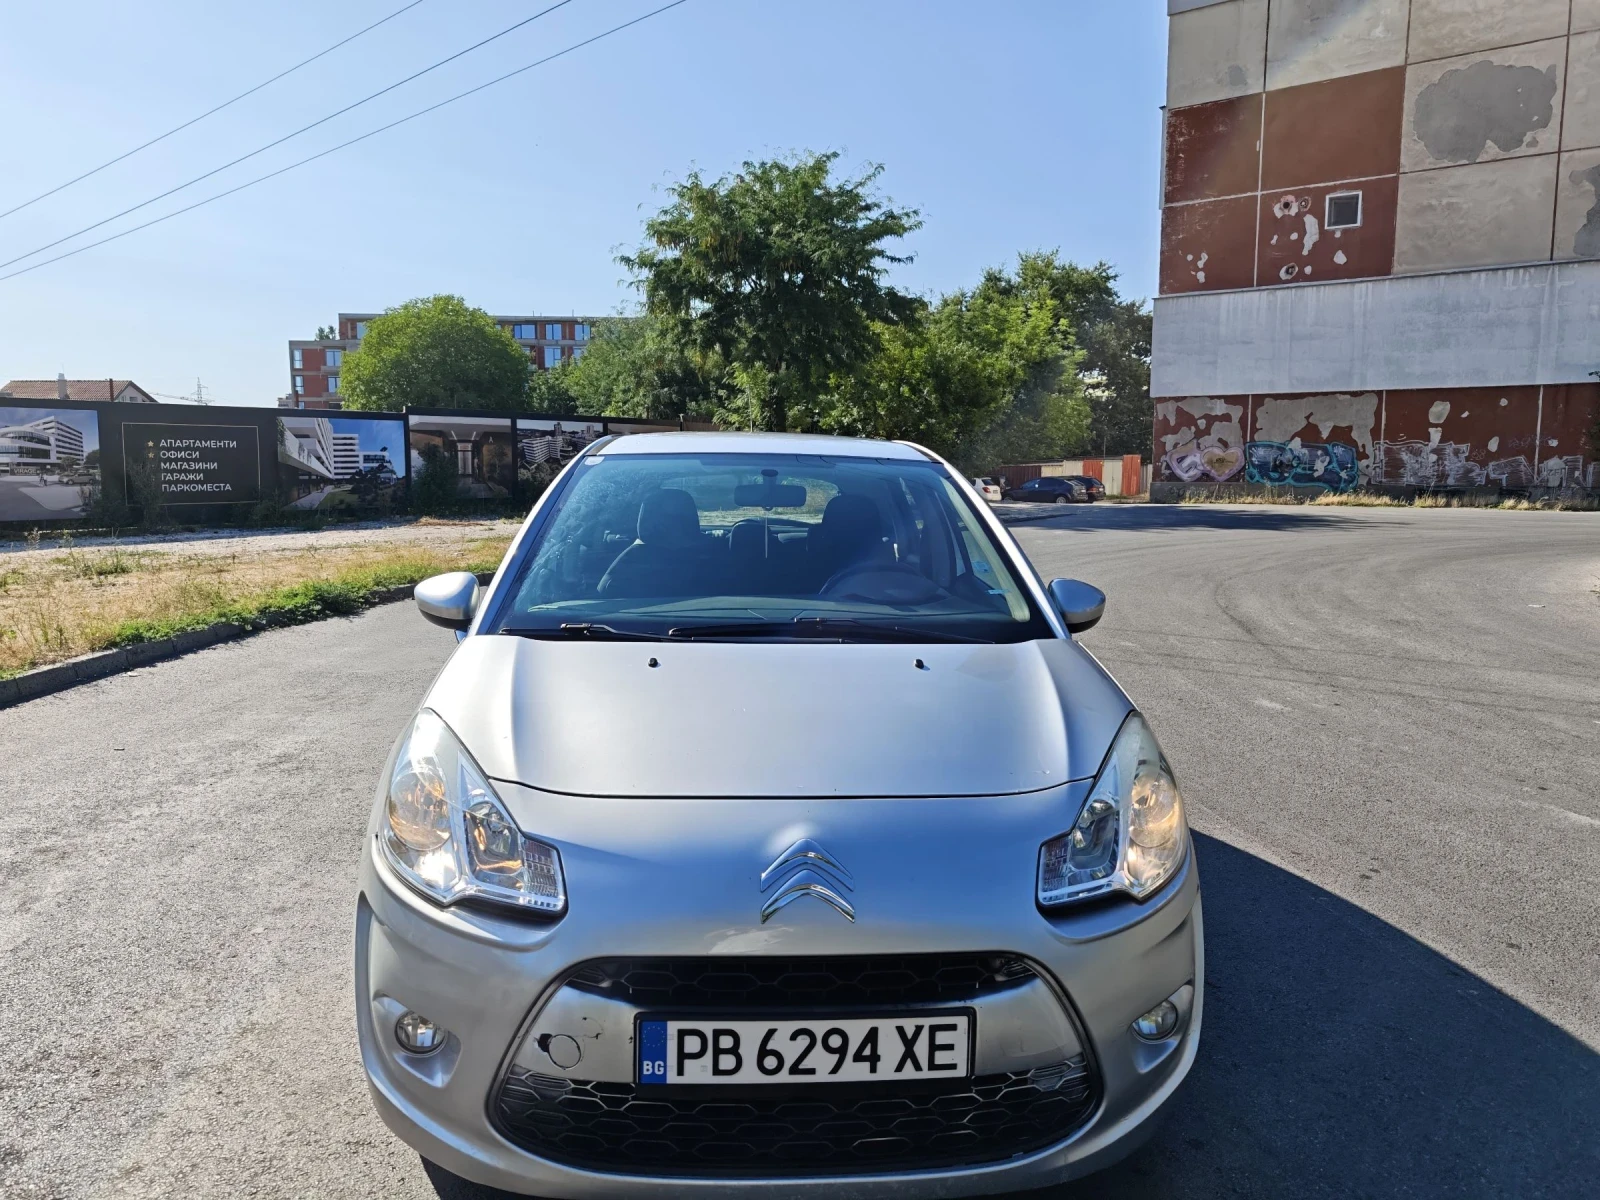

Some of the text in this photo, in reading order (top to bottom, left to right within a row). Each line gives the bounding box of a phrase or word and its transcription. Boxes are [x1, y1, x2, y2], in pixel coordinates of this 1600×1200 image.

[160, 439, 237, 449] АПАРТАМЕНТИ
[160, 450, 200, 459] ОФИСИ
[160, 461, 218, 470] МАГАЗИНИ
[161, 472, 204, 481] ГАРАЖИ
[161, 483, 232, 492] ПАРКОМЕСТА
[676, 1023, 958, 1077] PB 6294 XE
[642, 1060, 665, 1075] BG
